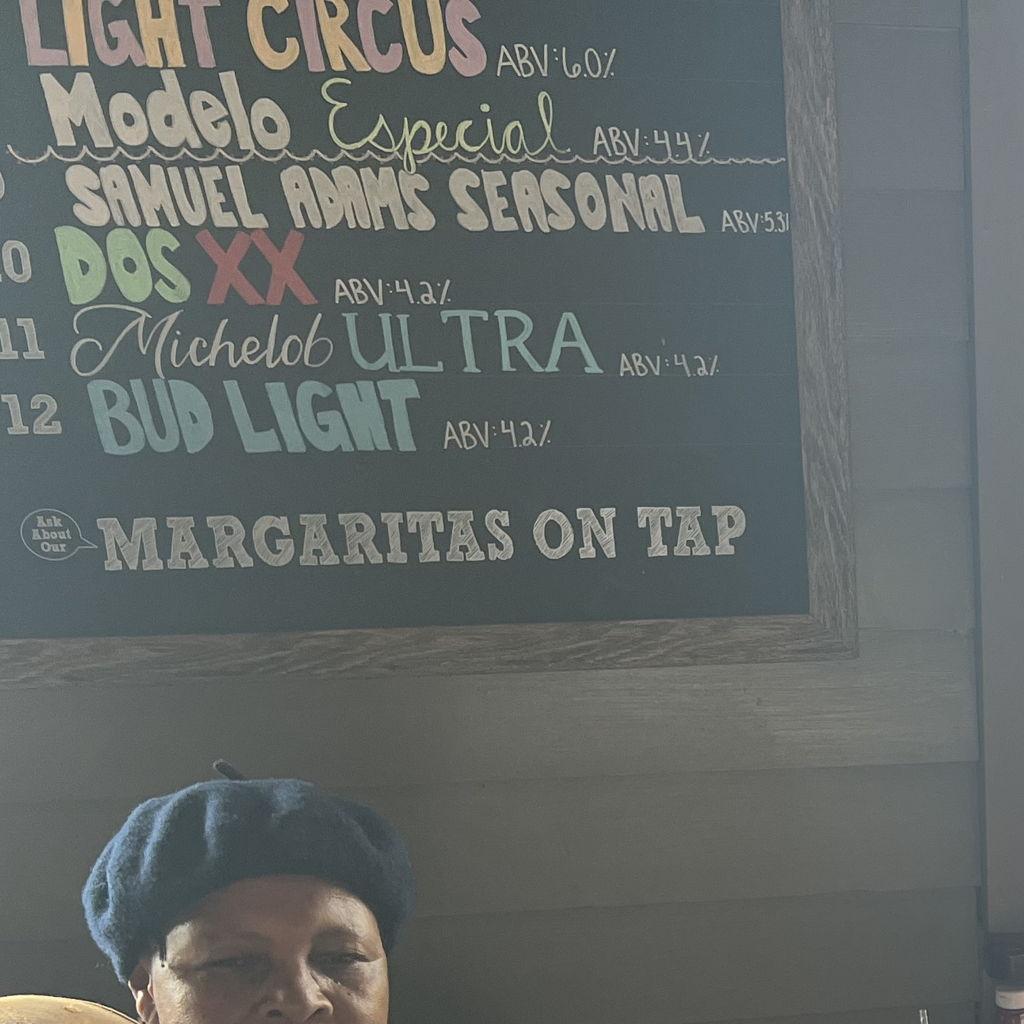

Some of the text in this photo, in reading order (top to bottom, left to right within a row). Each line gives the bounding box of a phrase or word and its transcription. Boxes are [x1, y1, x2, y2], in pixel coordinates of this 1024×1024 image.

[19, 0, 221, 67] LIGHT
[246, 0, 487, 77] CIRCUS
[39, 69, 291, 150] Modelo
[321, 77, 571, 174] Especial
[65, 164, 269, 228] SAMUEL
[280, 165, 436, 232] ADAMS
[448, 168, 706, 234] SEASONAL
[54, 225, 192, 304] DOS
[195, 228, 318, 305] XX
[70, 304, 334, 379] Michelob
[341, 309, 604, 374] ULTRA
[1, 393, 63, 435] 12
[86, 378, 214, 456] BUD
[223, 378, 421, 454] LIGHT
[32, 528, 72, 540] About
[36, 515, 63, 528] Ask
[40, 541, 67, 553] Our
[97, 505, 747, 572] MARGARITAS ON TAP
